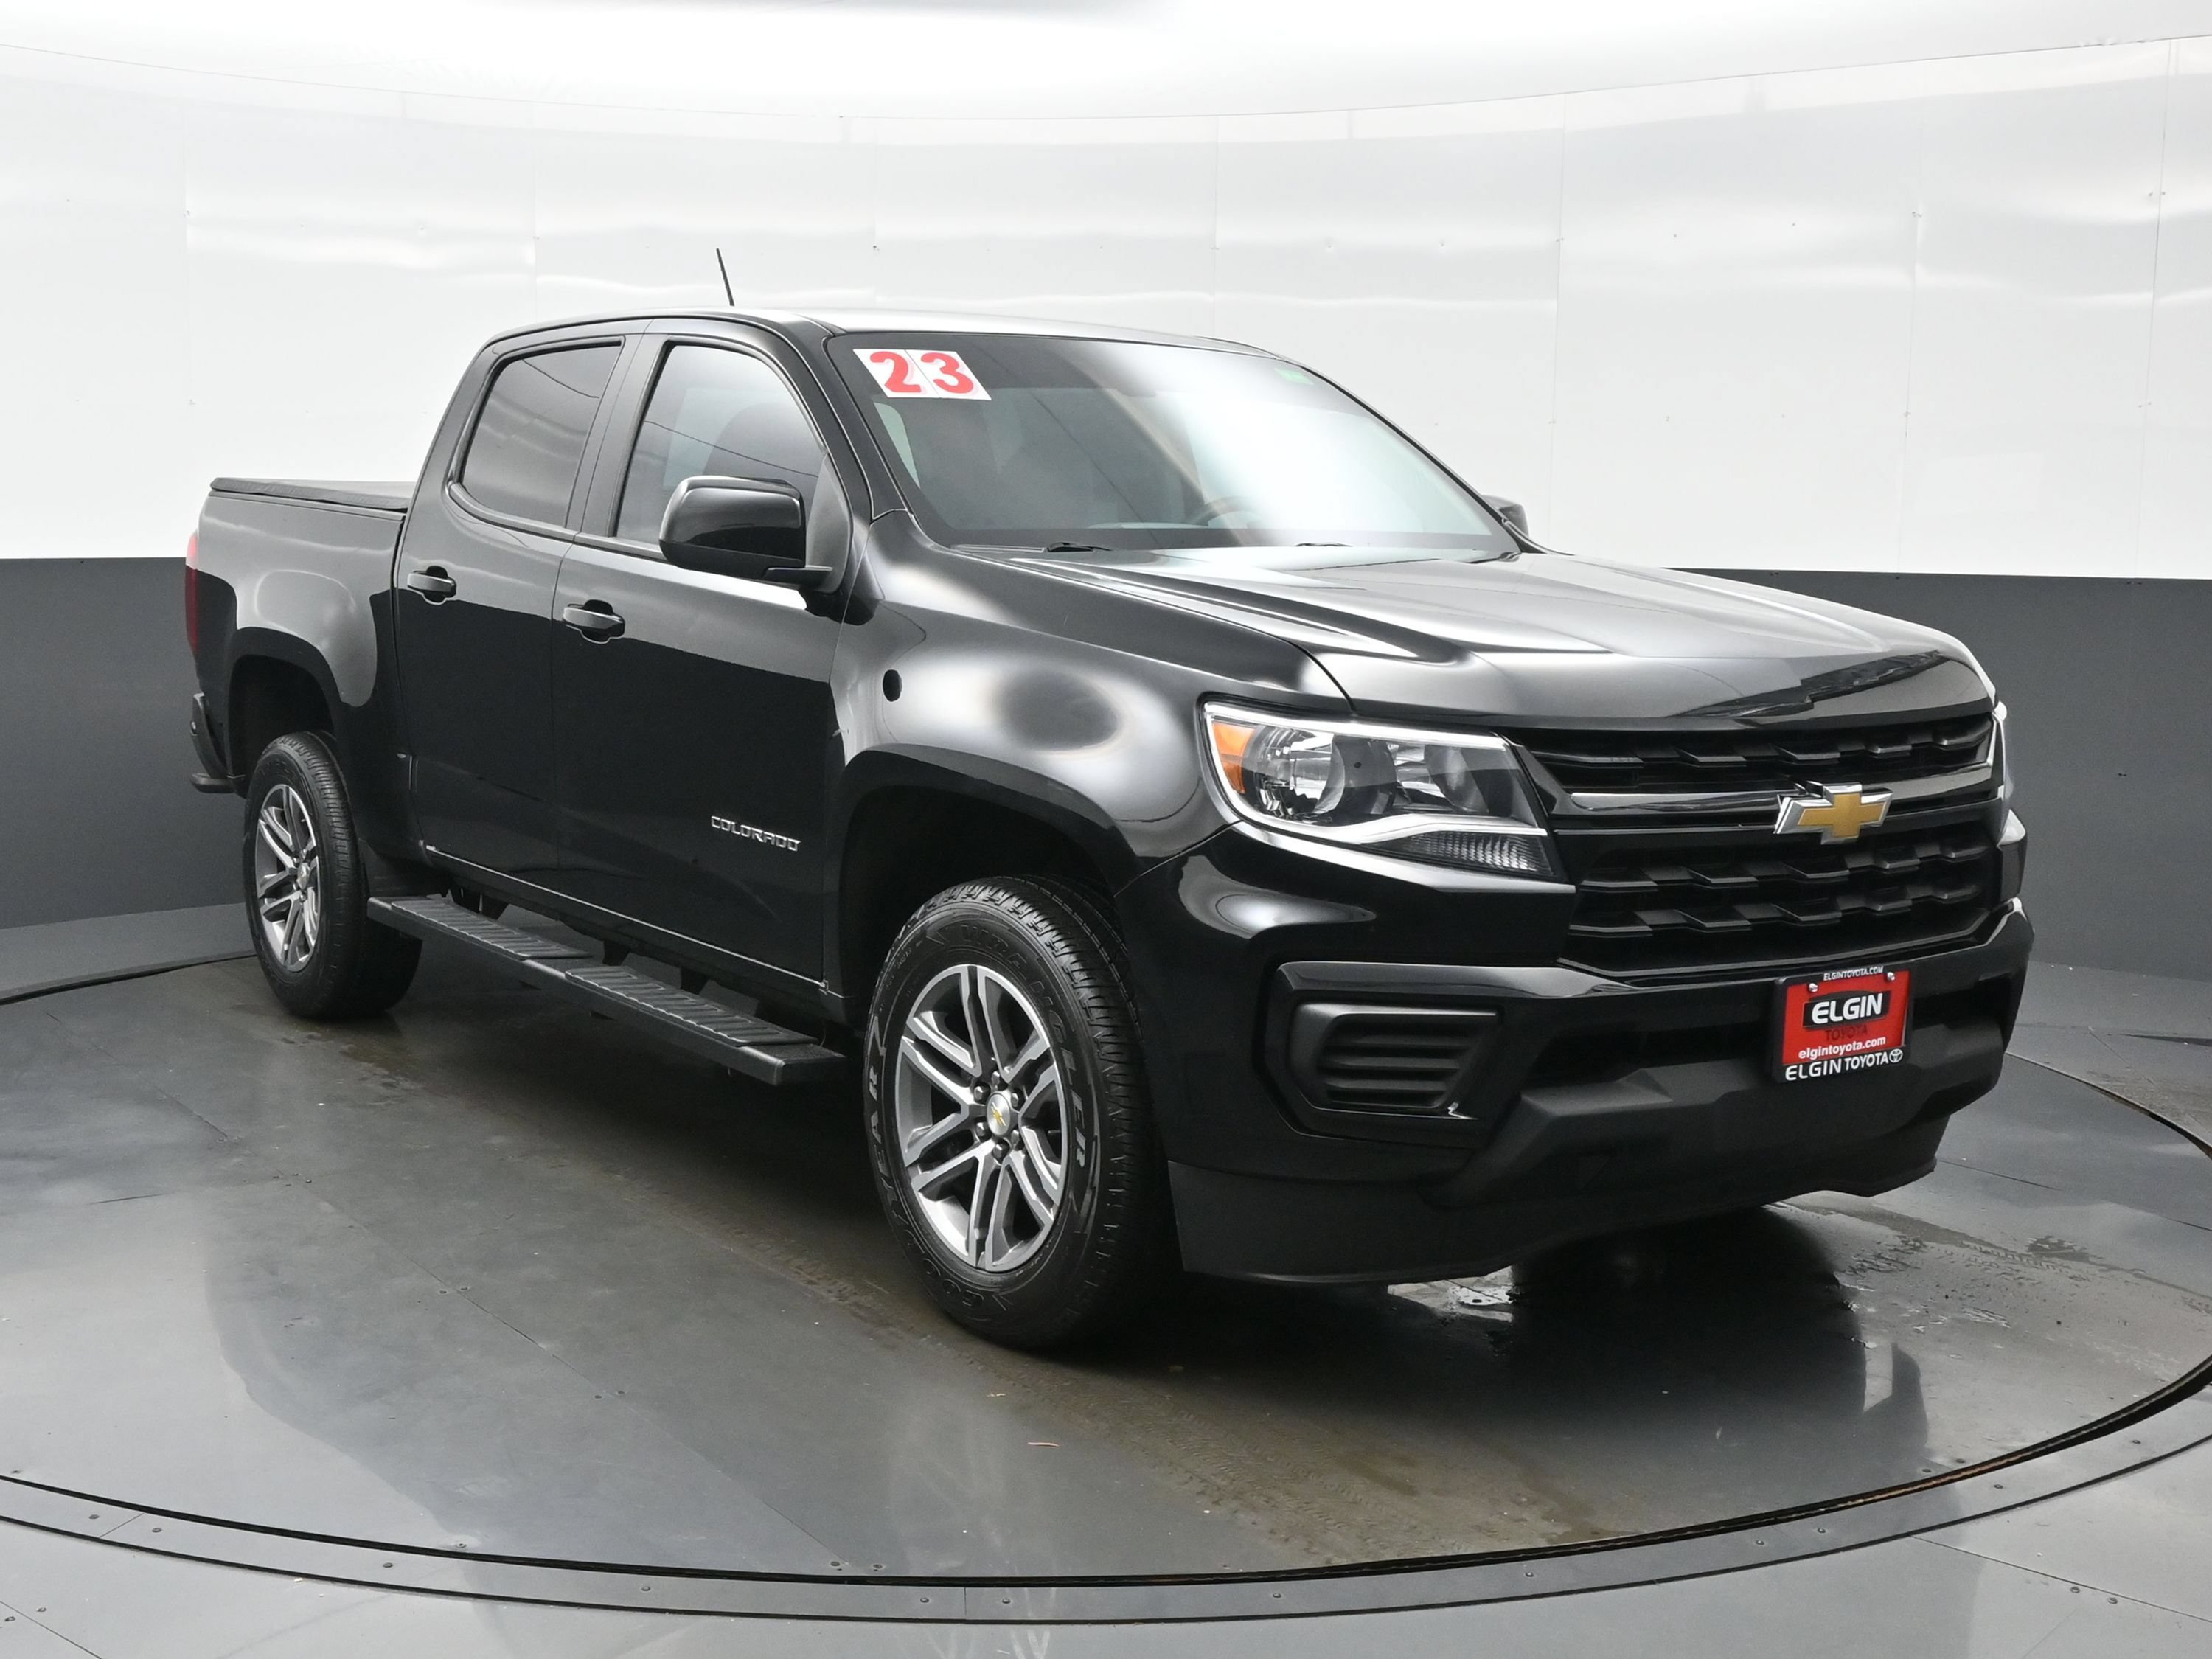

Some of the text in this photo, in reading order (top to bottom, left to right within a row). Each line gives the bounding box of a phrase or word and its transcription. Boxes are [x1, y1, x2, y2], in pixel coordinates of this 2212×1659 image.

[870, 351, 974, 394] 23
[711, 815, 801, 852] COLORADO
[1823, 966, 1884, 981] ELGINTOYOTA.COM
[1811, 992, 1883, 1024] ELGIN
[1798, 1036, 1886, 1060] elgintoyota.com
[1824, 1025, 1868, 1041] TOYOTA
[1784, 1051, 1890, 1081] ELGIN TOYOTA
